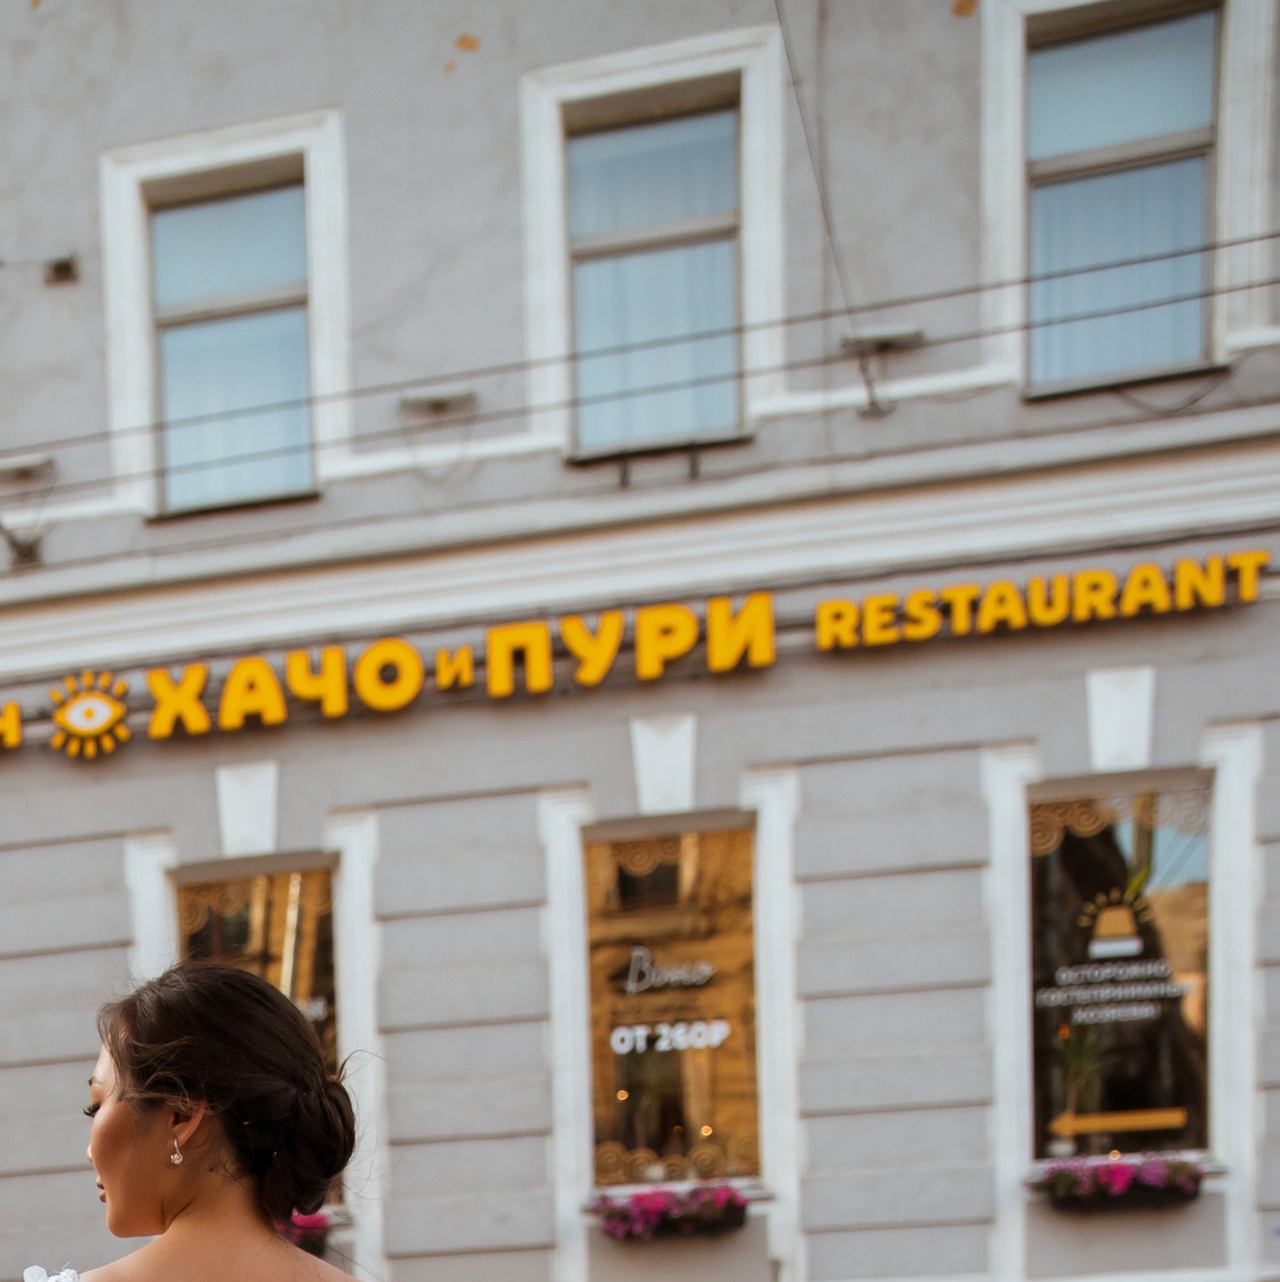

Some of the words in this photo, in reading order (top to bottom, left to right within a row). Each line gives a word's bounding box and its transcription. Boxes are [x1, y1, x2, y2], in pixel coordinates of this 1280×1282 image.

[815, 549, 1271, 651] RESTAURANT
[146, 636, 424, 739] ХАЧО
[435, 644, 474, 692] и
[485, 590, 777, 699] ПУРИ
[610, 1024, 651, 1055] ОТ
